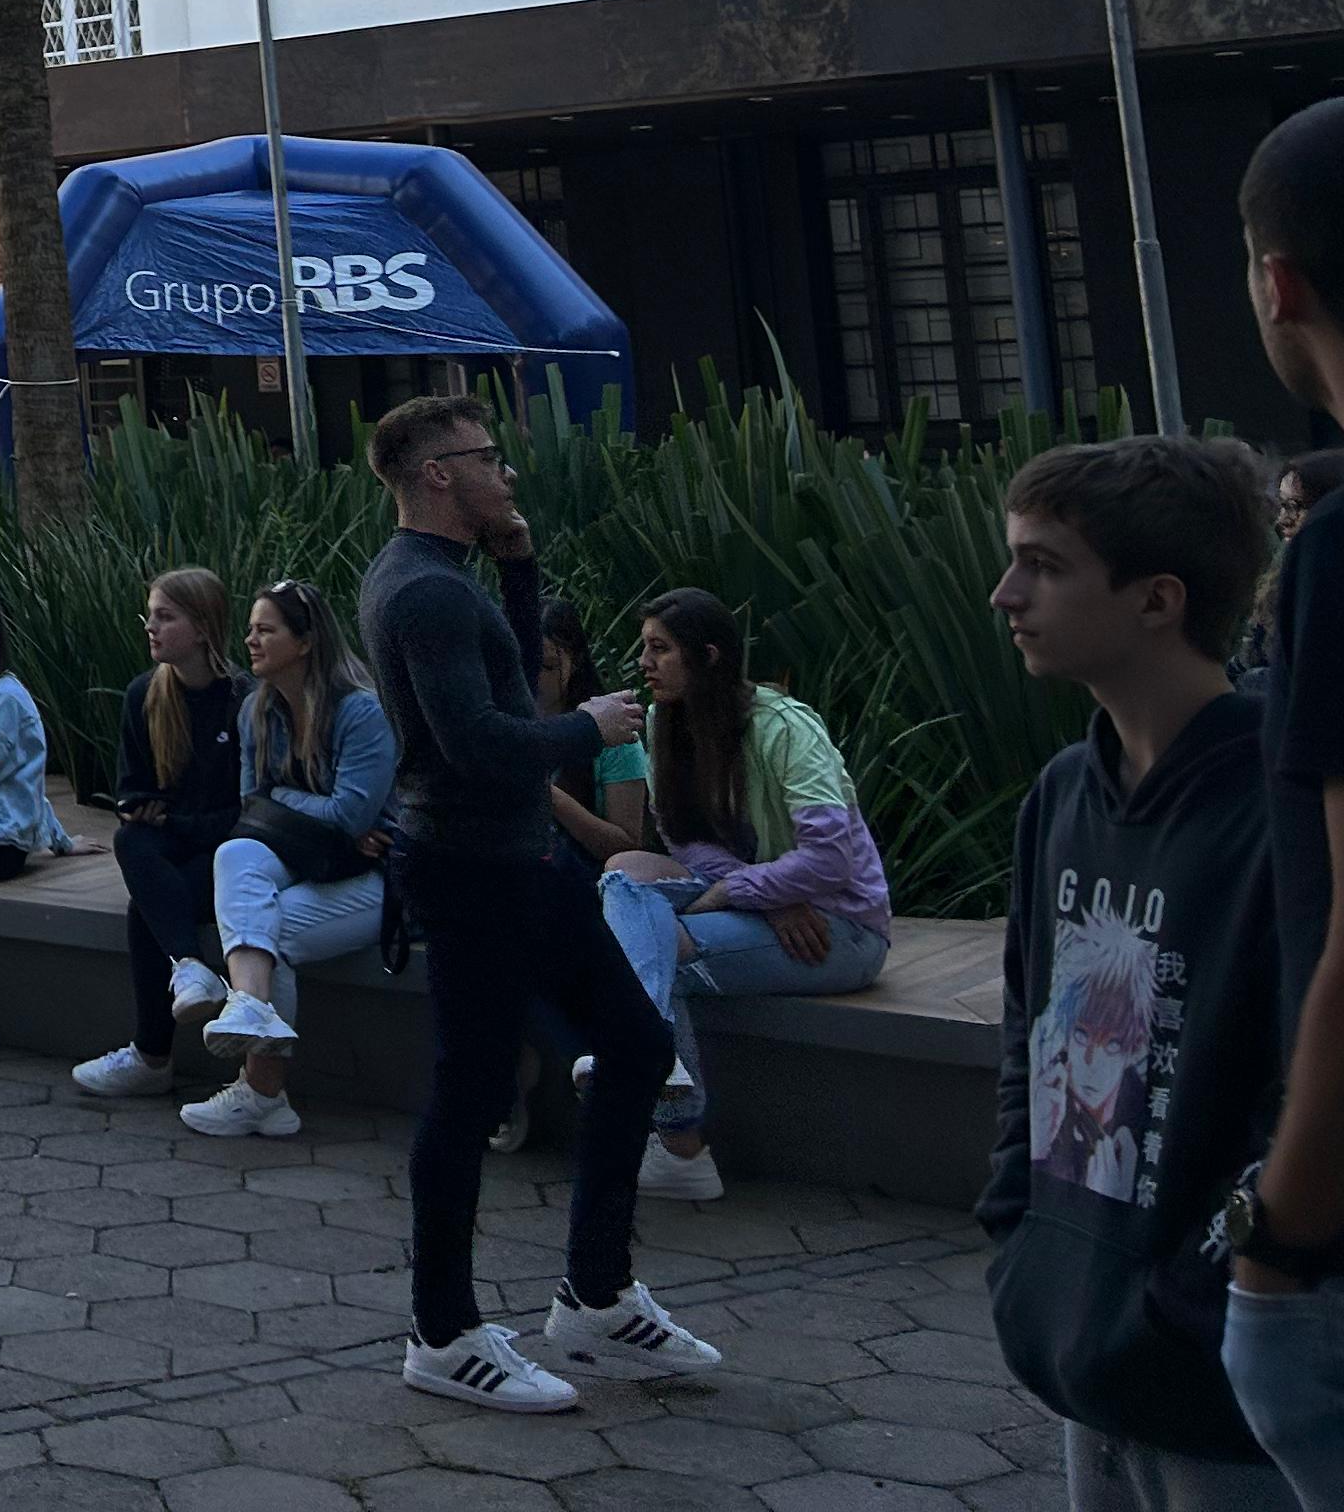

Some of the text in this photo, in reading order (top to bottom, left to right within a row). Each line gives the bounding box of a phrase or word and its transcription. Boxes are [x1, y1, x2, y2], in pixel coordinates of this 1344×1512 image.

[125, 251, 436, 326] Grupo RBS
[1056, 867, 1166, 934] GOJO
